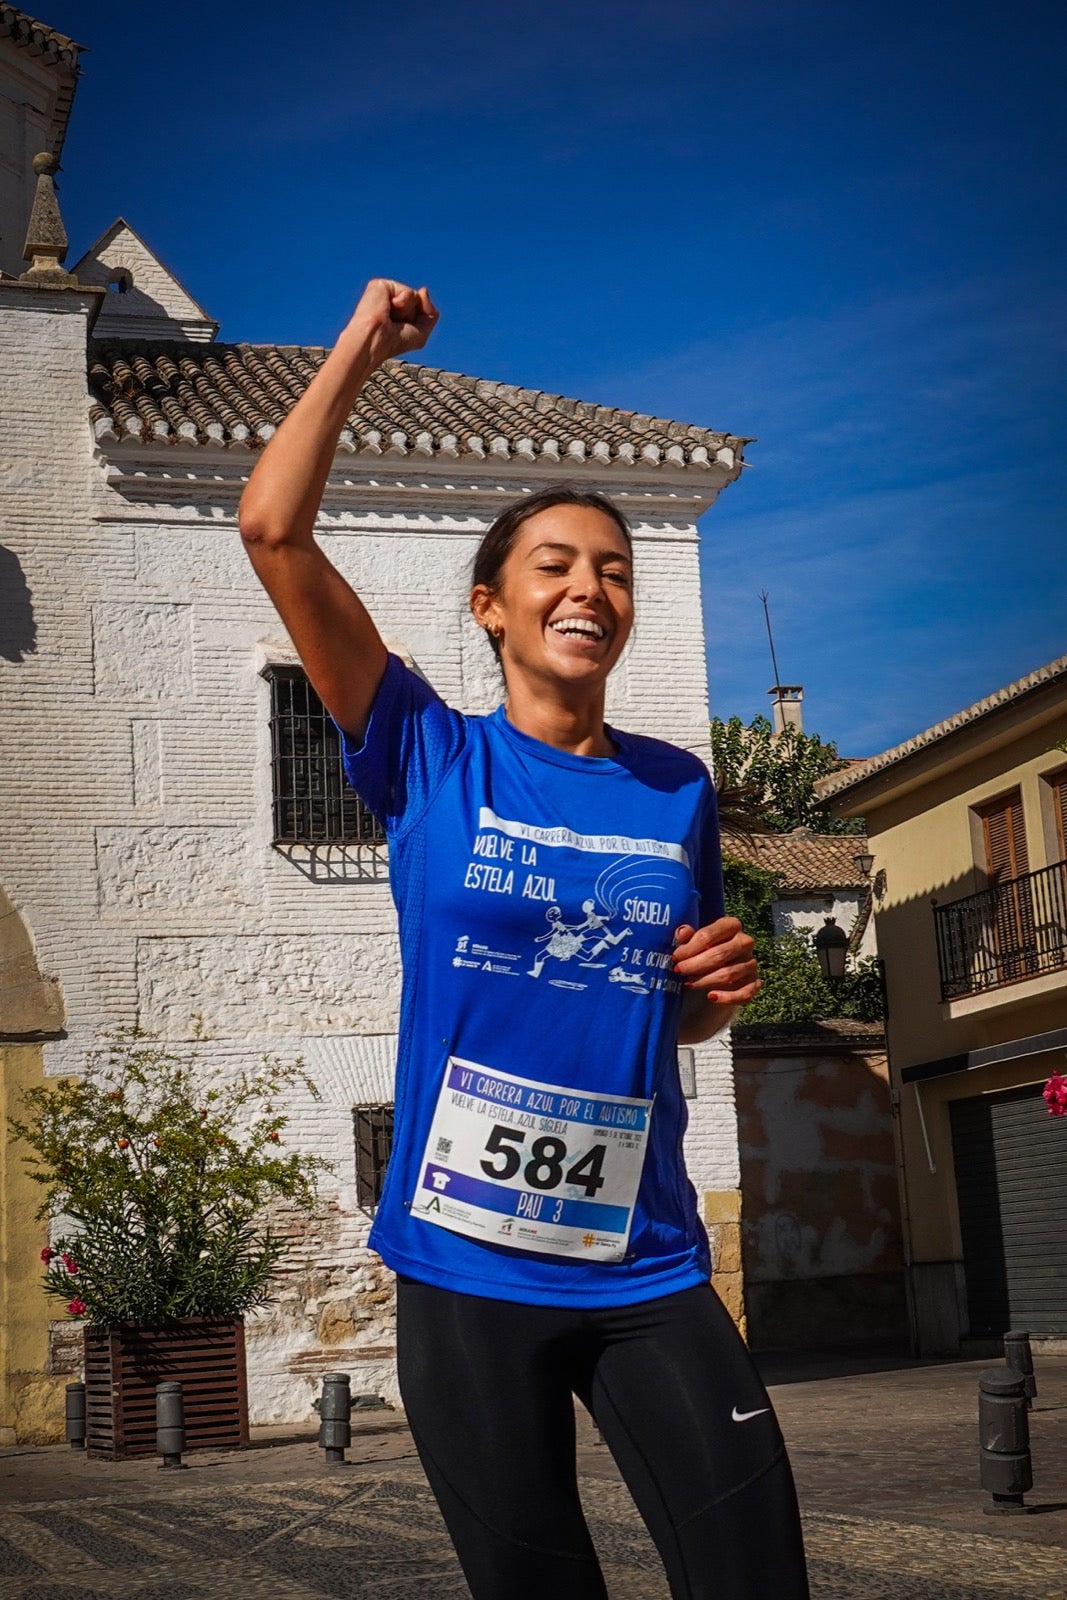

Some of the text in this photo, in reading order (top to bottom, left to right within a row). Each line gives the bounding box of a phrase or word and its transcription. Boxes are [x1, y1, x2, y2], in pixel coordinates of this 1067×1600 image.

[473, 834, 537, 866] VUELVE LA
[520, 825, 670, 856] VI CARRERA AZUL POR EL AUTISMO
[464, 862, 558, 902] ESTELA AZUL
[622, 896, 670, 926] SÍGUELA
[631, 948, 644, 965] DE
[451, 1092, 476, 1112] VUELVE
[477, 1103, 487, 1115] LA
[488, 1105, 514, 1124] ESTELA
[517, 1114, 536, 1129] AZUL
[461, 1071, 638, 1126] VI CARRERA AZUL POR EL AUTISMO
[479, 1124, 607, 1197] 584
[516, 1192, 564, 1223] PAU 3
